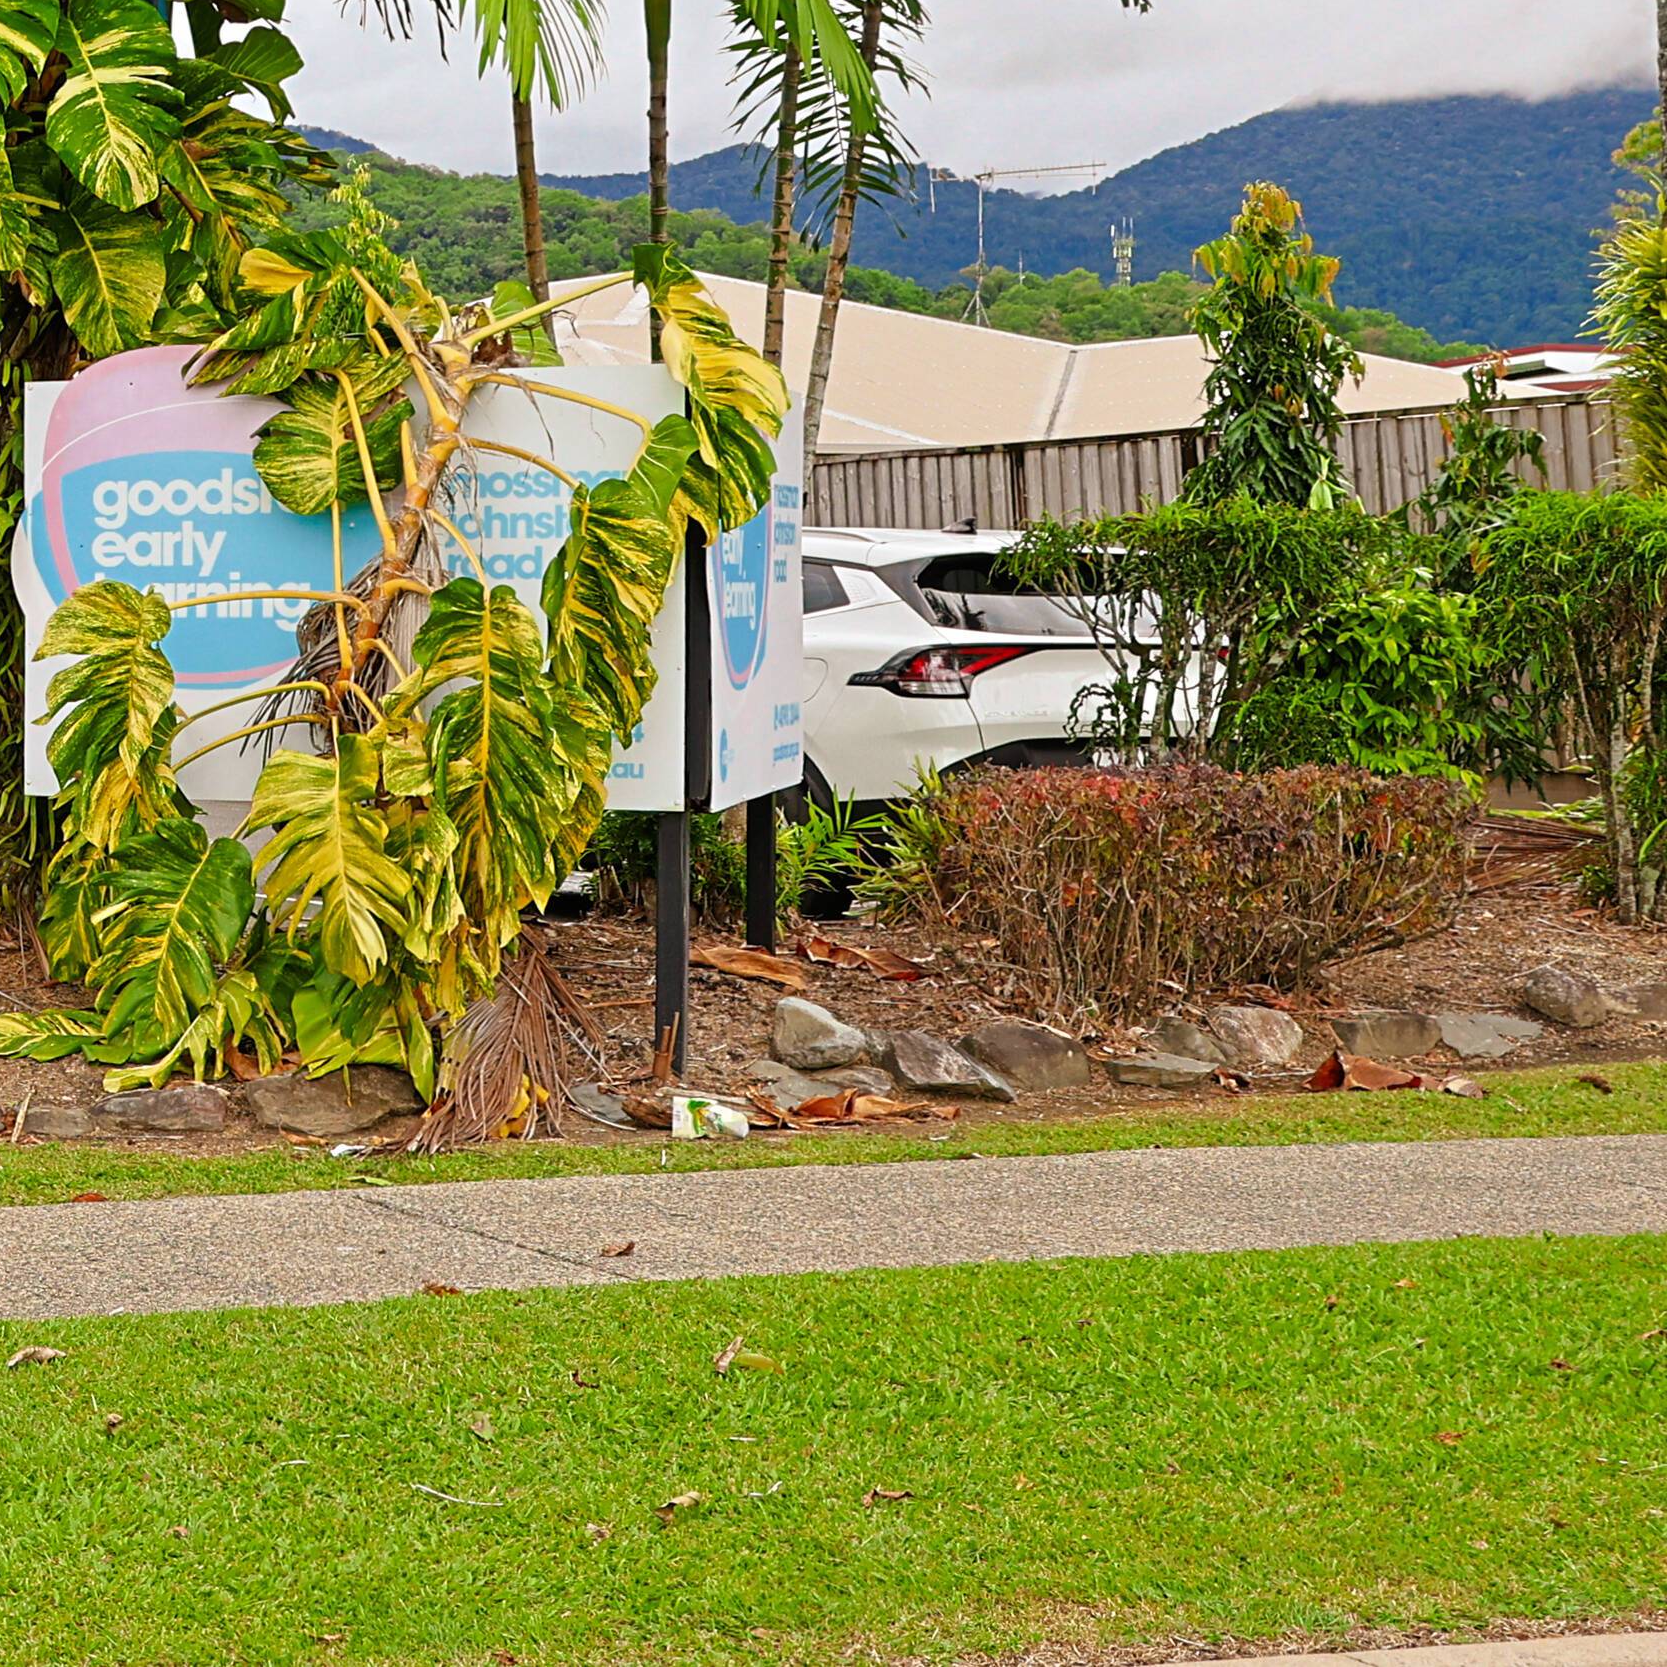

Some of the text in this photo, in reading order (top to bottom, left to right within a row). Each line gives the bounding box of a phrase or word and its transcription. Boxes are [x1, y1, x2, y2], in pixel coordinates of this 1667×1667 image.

[93, 467, 346, 529] goods
[445, 505, 572, 548] johnst
[91, 531, 227, 577] early
[447, 545, 543, 579] road
[95, 572, 311, 631] arning
